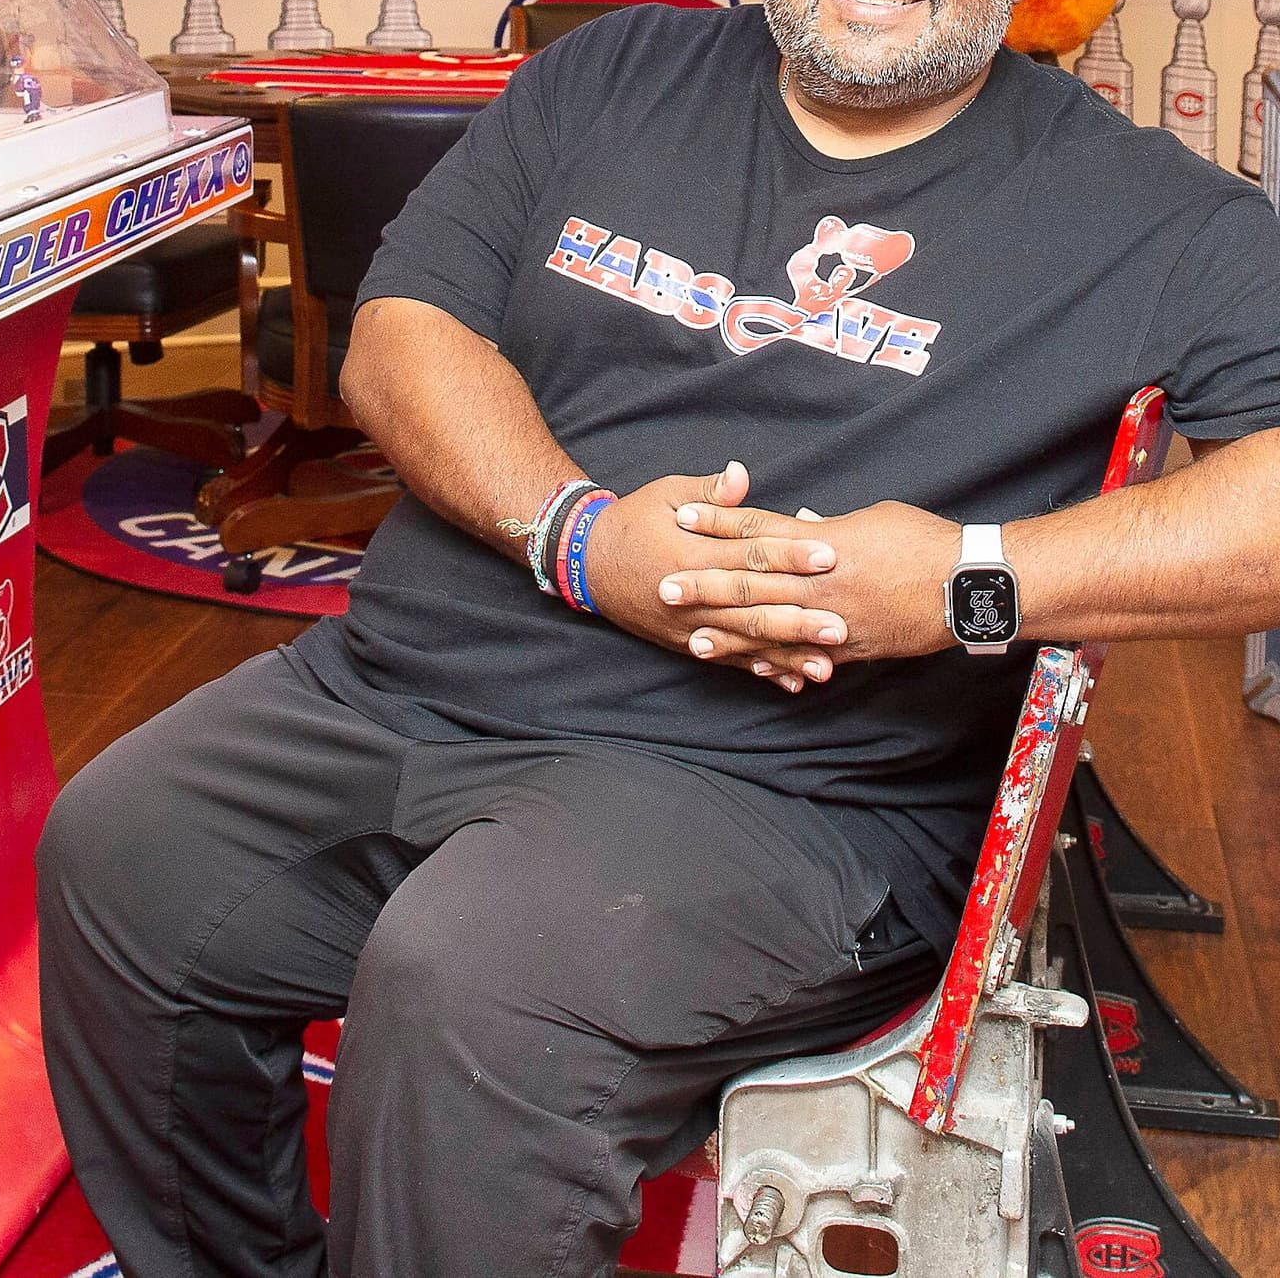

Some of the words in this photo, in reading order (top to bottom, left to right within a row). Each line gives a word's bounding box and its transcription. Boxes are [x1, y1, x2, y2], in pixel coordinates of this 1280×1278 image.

[105, 145, 232, 242] CHEXX
[575, 513, 593, 537] Kat
[571, 542, 582, 554] D
[570, 558, 585, 601] Strong
